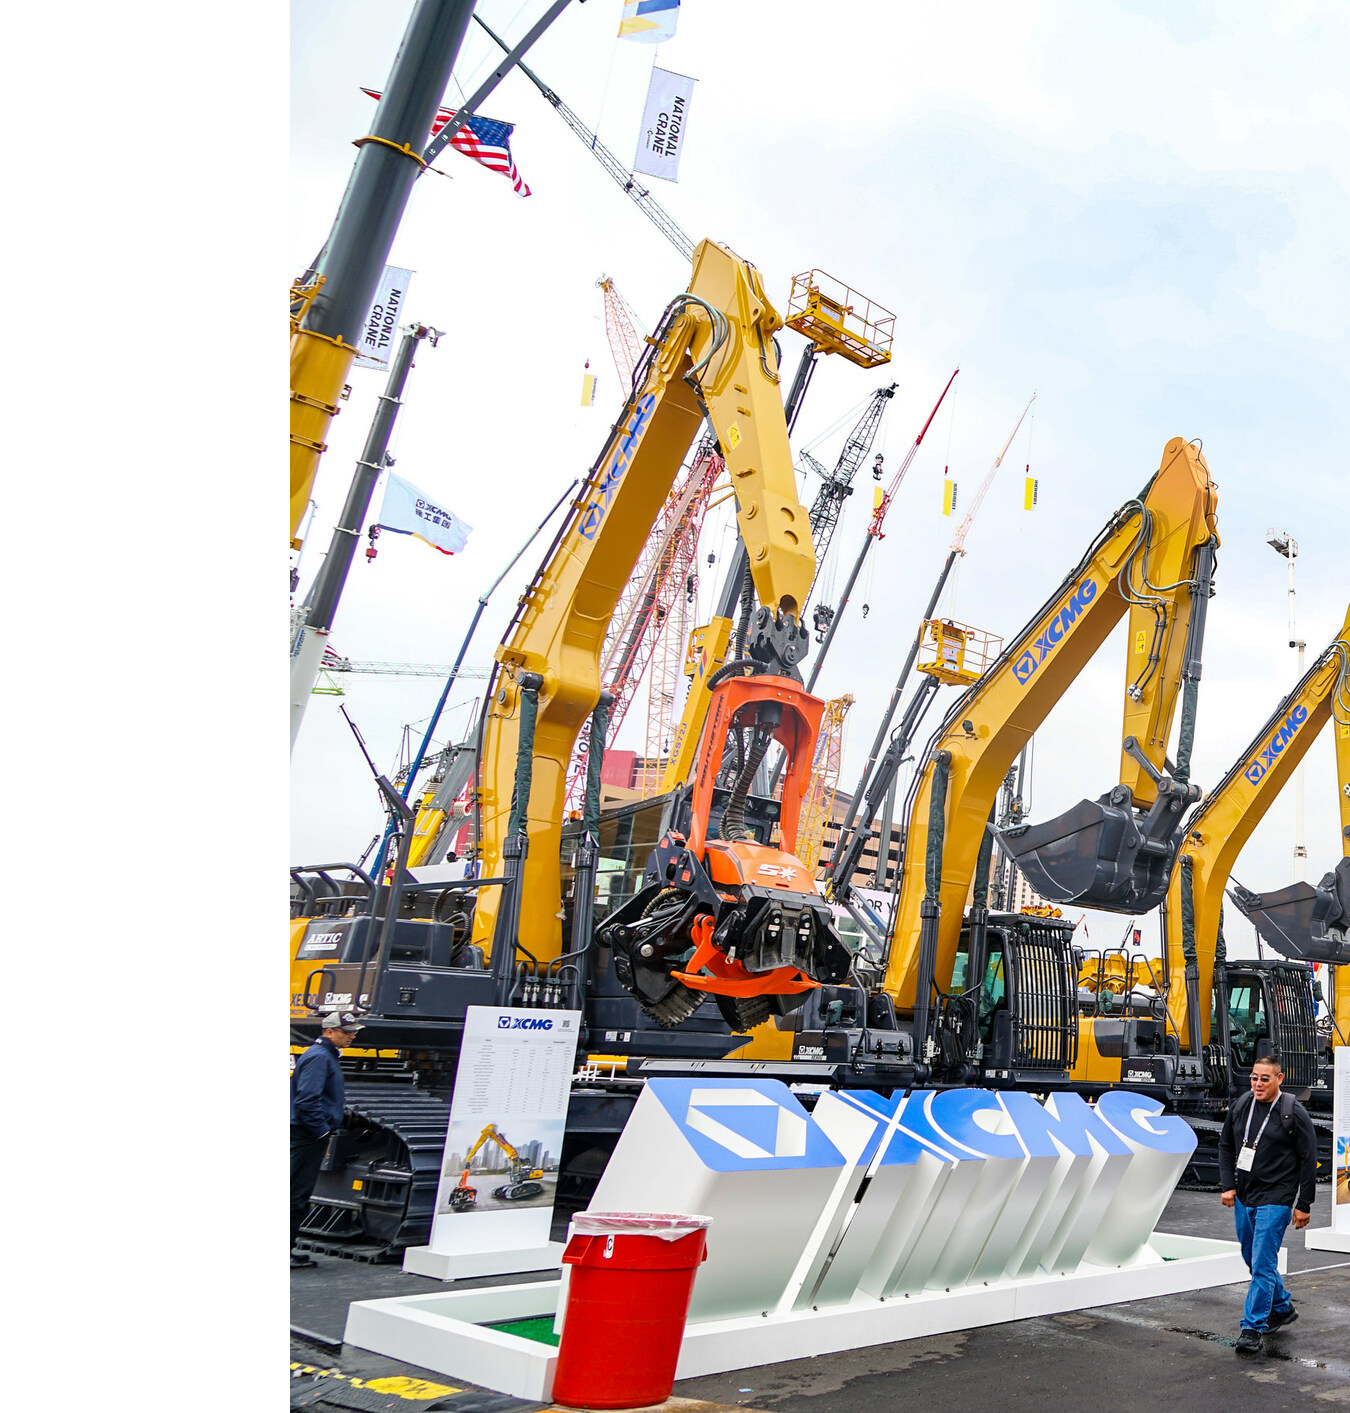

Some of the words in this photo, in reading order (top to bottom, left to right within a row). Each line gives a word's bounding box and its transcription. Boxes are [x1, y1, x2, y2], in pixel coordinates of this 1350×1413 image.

[652, 112, 669, 155] CRANE
[664, 95, 685, 157] NATIONAL
[365, 304, 384, 347] CRANE
[377, 288, 402, 349] NATIONAL
[597, 392, 656, 511] XCMG
[1033, 578, 1097, 666] XCMG
[670, 722, 688, 766] XGS72J
[1260, 704, 1308, 770] XCMG
[306, 932, 343, 944] ARTIC
[512, 1018, 554, 1031] XCMG
[836, 1088, 1198, 1167] XCMG
